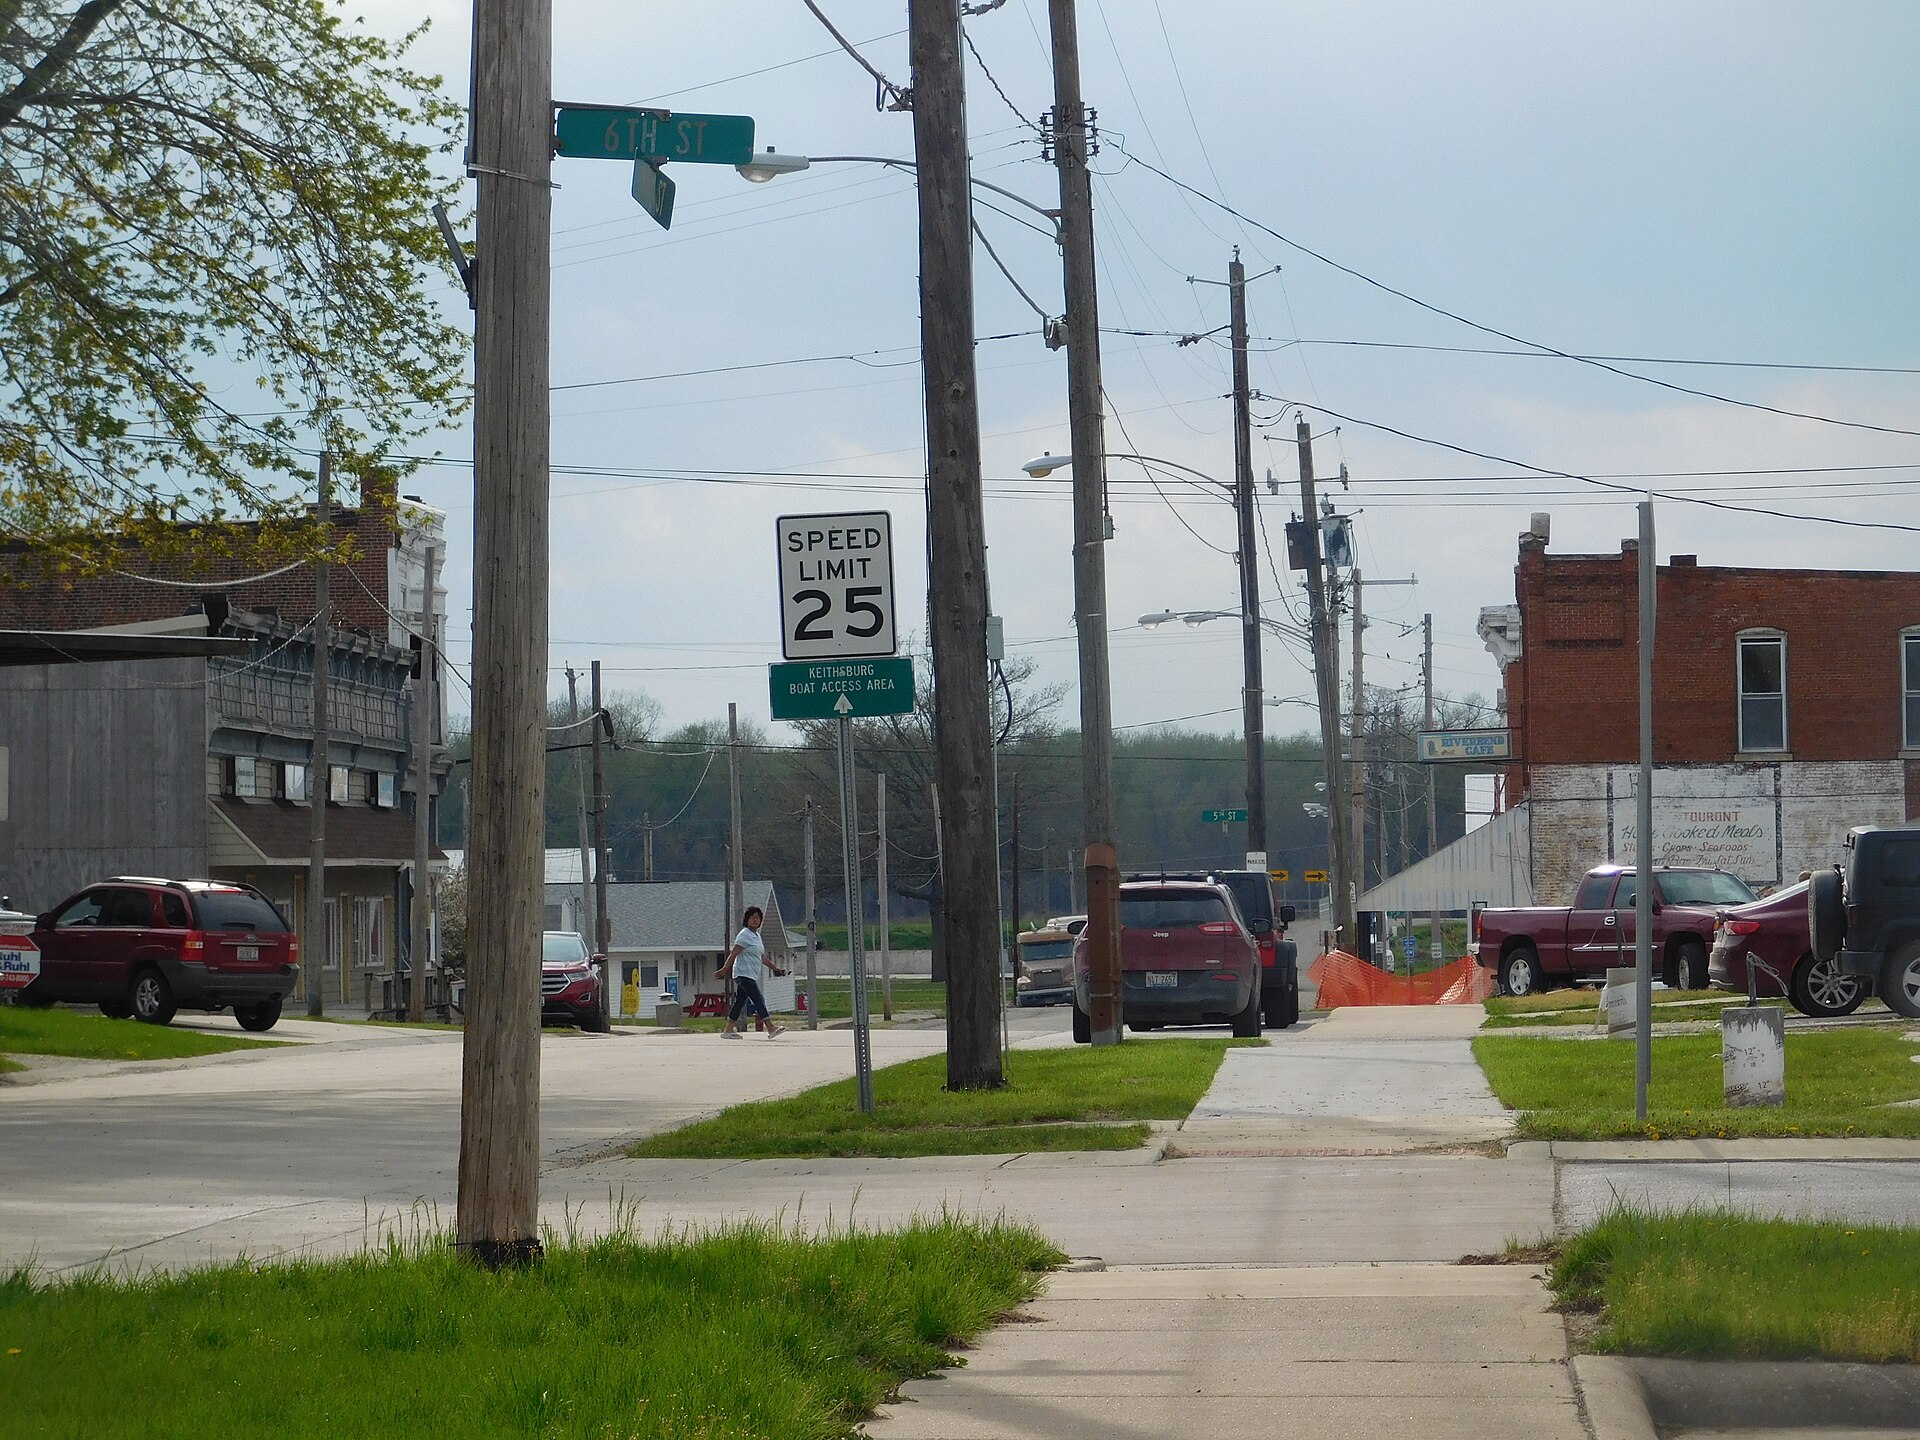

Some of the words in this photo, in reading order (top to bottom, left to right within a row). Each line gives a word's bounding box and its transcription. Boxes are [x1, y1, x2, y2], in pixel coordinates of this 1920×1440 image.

[605, 118, 658, 153] 6TH
[675, 120, 709, 155] ST
[787, 527, 882, 552] SPEED
[799, 557, 872, 581] LIMIT
[792, 585, 885, 641] 25
[809, 664, 875, 679] KEITHSBURG
[789, 682, 816, 695] BOAT
[821, 679, 862, 693] ACCESS
[867, 678, 895, 691] AREA
[1441, 735, 1505, 748] RIVERBEND
[1465, 745, 1495, 756] CAFE
[1227, 811, 1237, 821] ST
[1722, 823, 1764, 839] Meals
